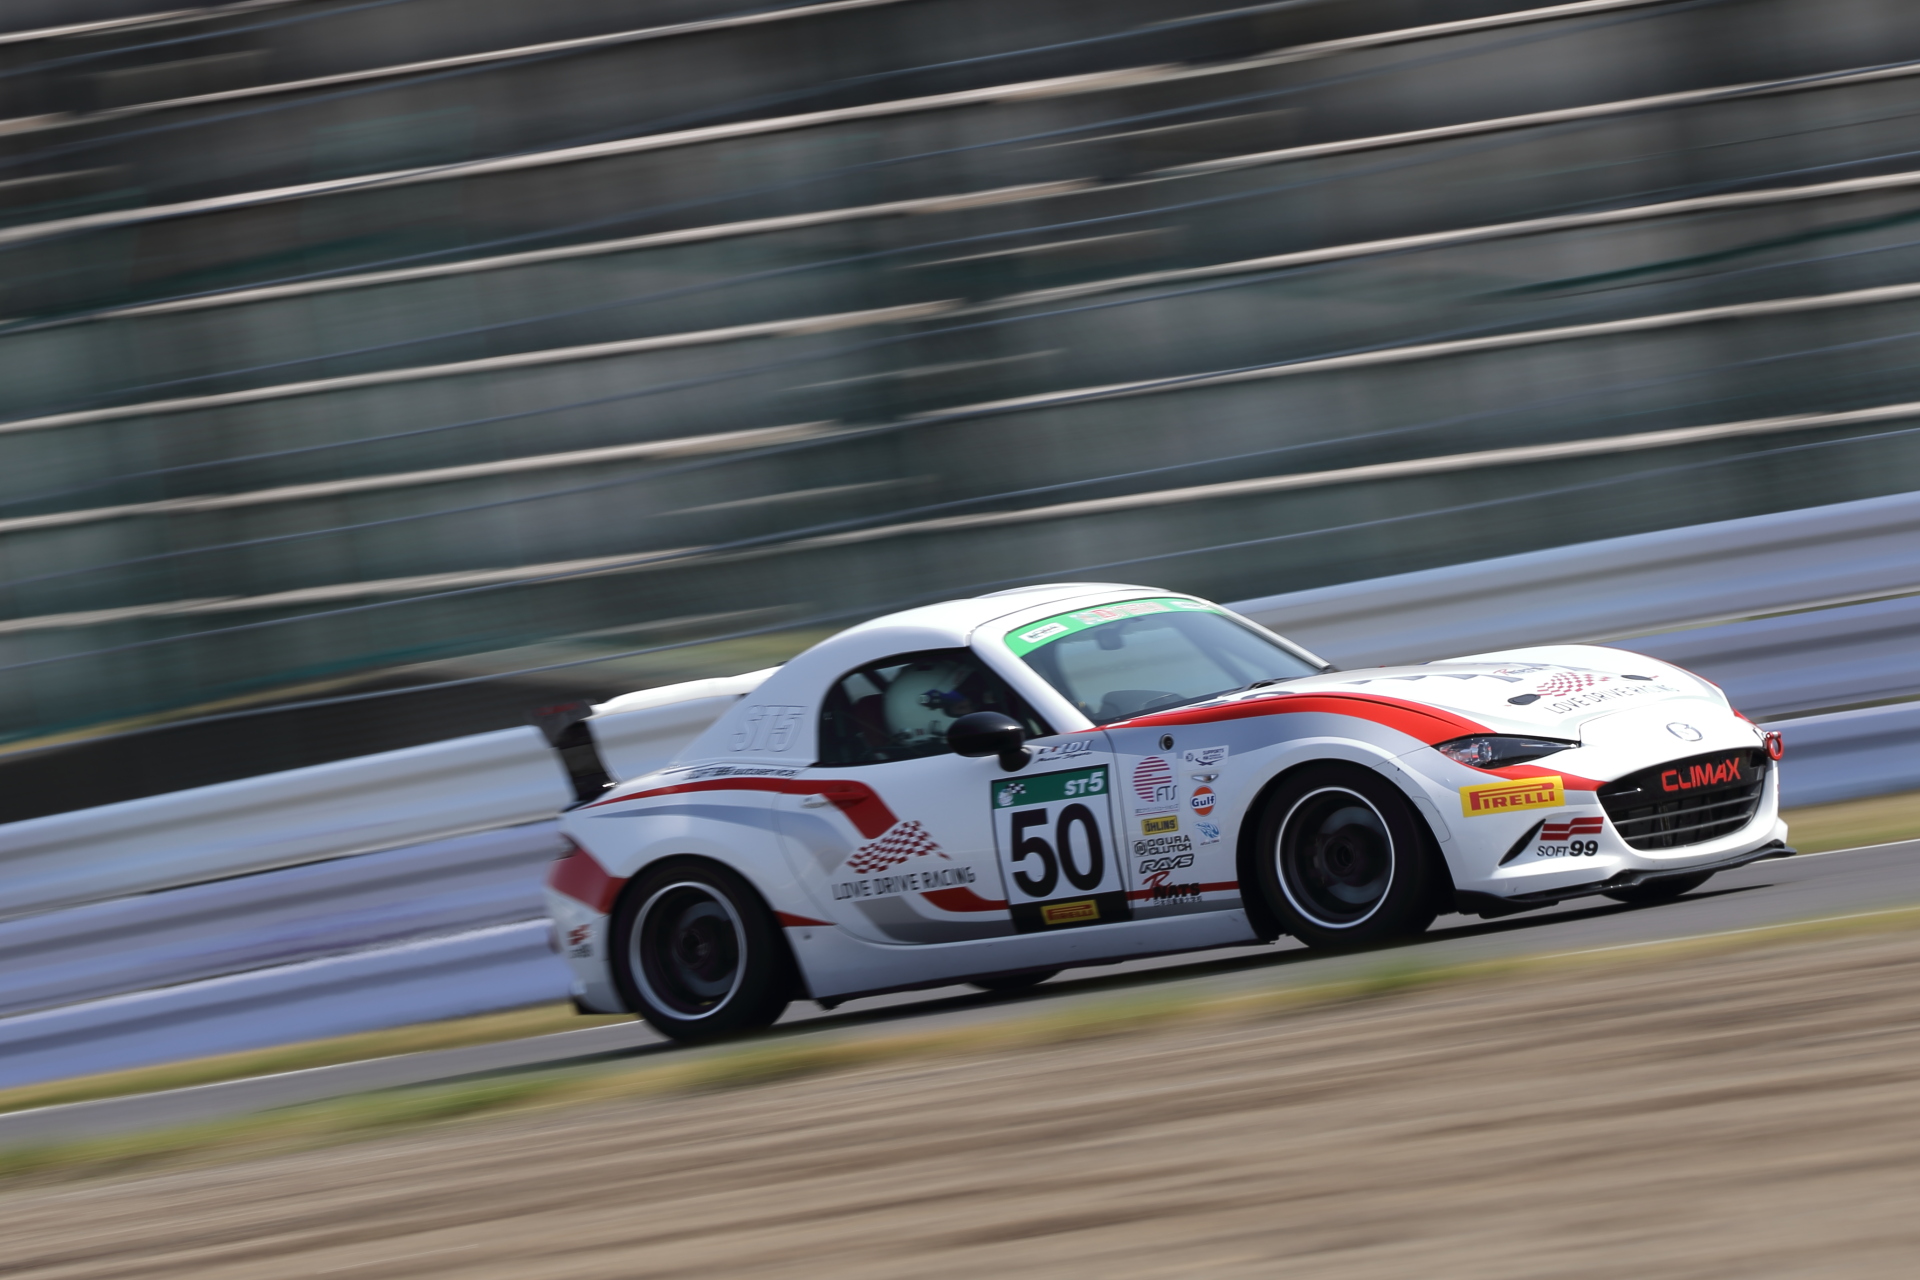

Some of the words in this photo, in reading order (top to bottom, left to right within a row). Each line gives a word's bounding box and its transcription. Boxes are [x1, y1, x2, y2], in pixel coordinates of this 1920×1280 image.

[1544, 697, 1591, 714] LOVE
[1064, 771, 1105, 796] ST5
[1661, 757, 1741, 792] CLIMAX
[1156, 785, 1178, 802] FTS
[1191, 796, 1215, 807] Gulf
[1469, 782, 1556, 811] PIRELLI
[1010, 802, 1105, 898] 50
[1147, 834, 1191, 847] OGURA
[1148, 842, 1192, 855] CLUTCH
[1139, 853, 1195, 874] RAYS
[831, 879, 871, 900] LOVE
[873, 873, 921, 895] DRIVE
[921, 866, 977, 889] RACING
[1153, 883, 1201, 900] NATS
